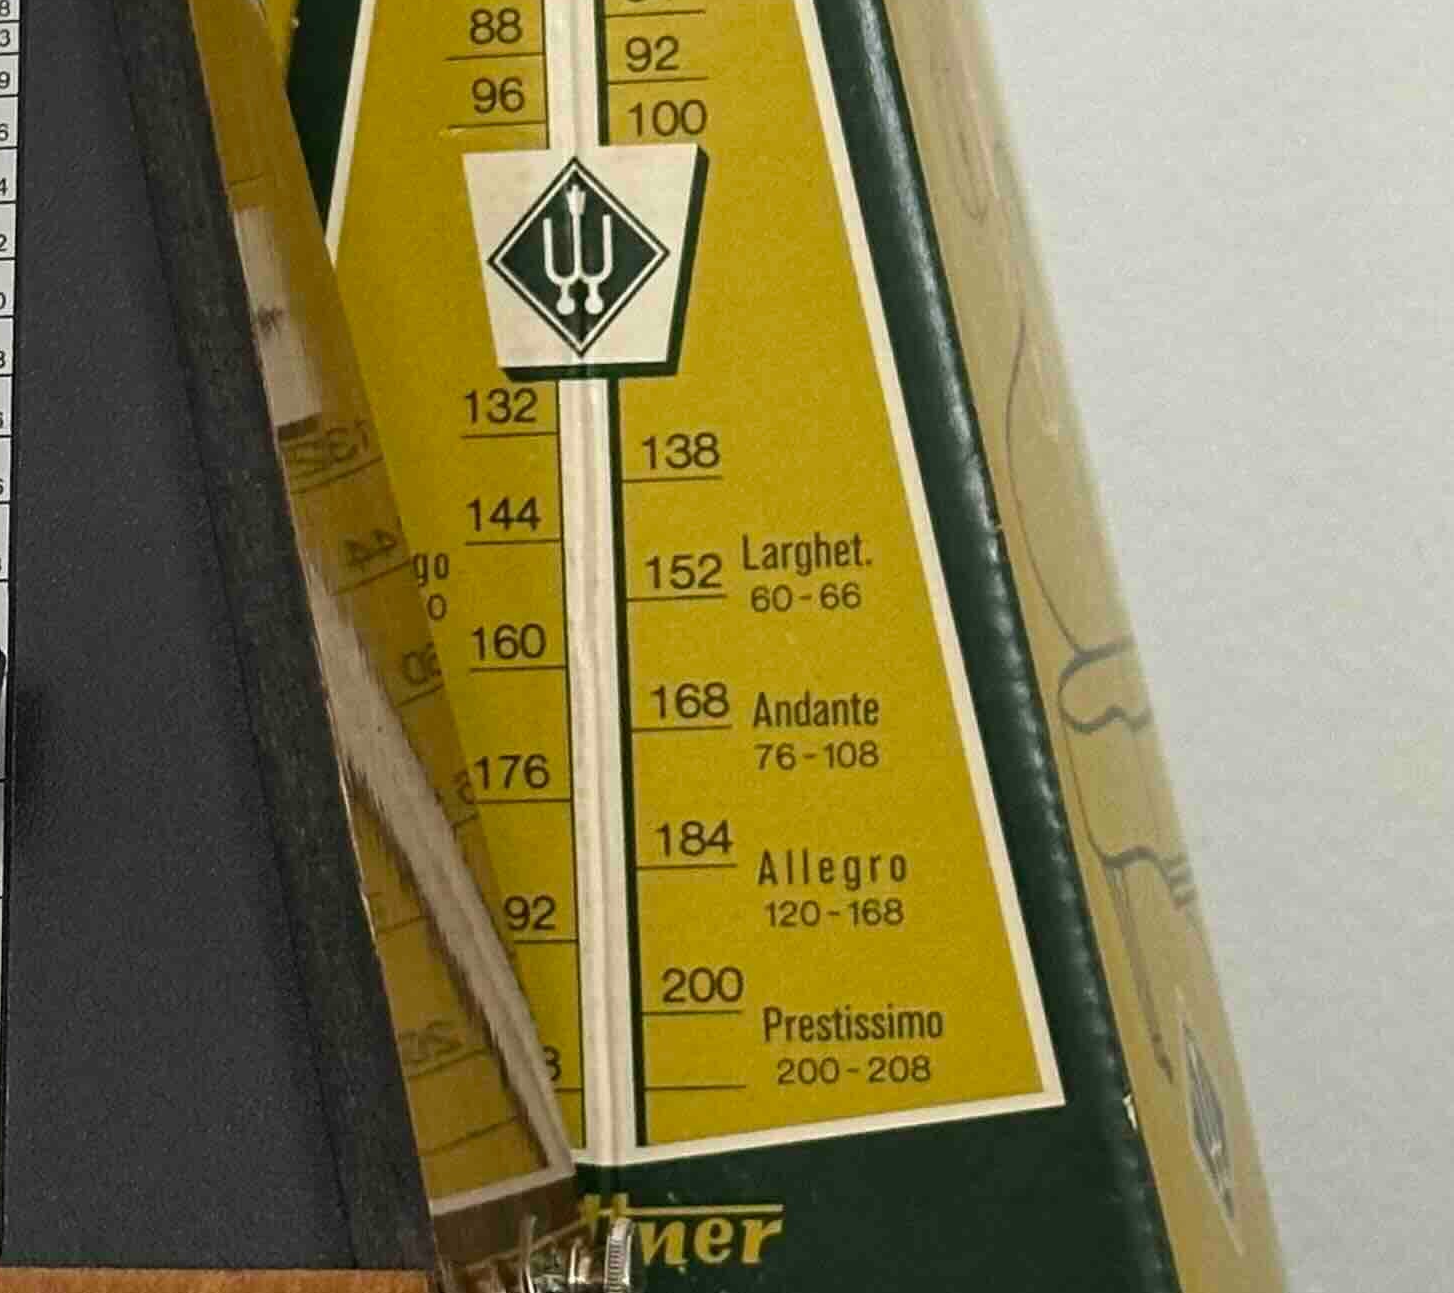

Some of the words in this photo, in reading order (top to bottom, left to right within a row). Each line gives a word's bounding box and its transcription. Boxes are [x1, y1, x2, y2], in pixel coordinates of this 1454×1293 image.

[470, 8, 522, 44] 88
[626, 36, 679, 72] 92
[472, 78, 525, 113] 96
[629, 99, 707, 136] 100
[465, 388, 537, 423] 132
[643, 433, 720, 468] 138
[467, 498, 540, 531] 144
[647, 554, 723, 590] 152
[742, 533, 872, 577] Larghet.
[472, 624, 545, 660] 160
[651, 684, 728, 719] 168
[753, 692, 880, 727] Andante
[475, 754, 549, 789] 176
[657, 821, 733, 857] 184
[759, 850, 907, 891] Allegro
[505, 895, 556, 931] 92
[663, 967, 743, 1003] 200
[763, 1006, 943, 1043] Prestissimo
